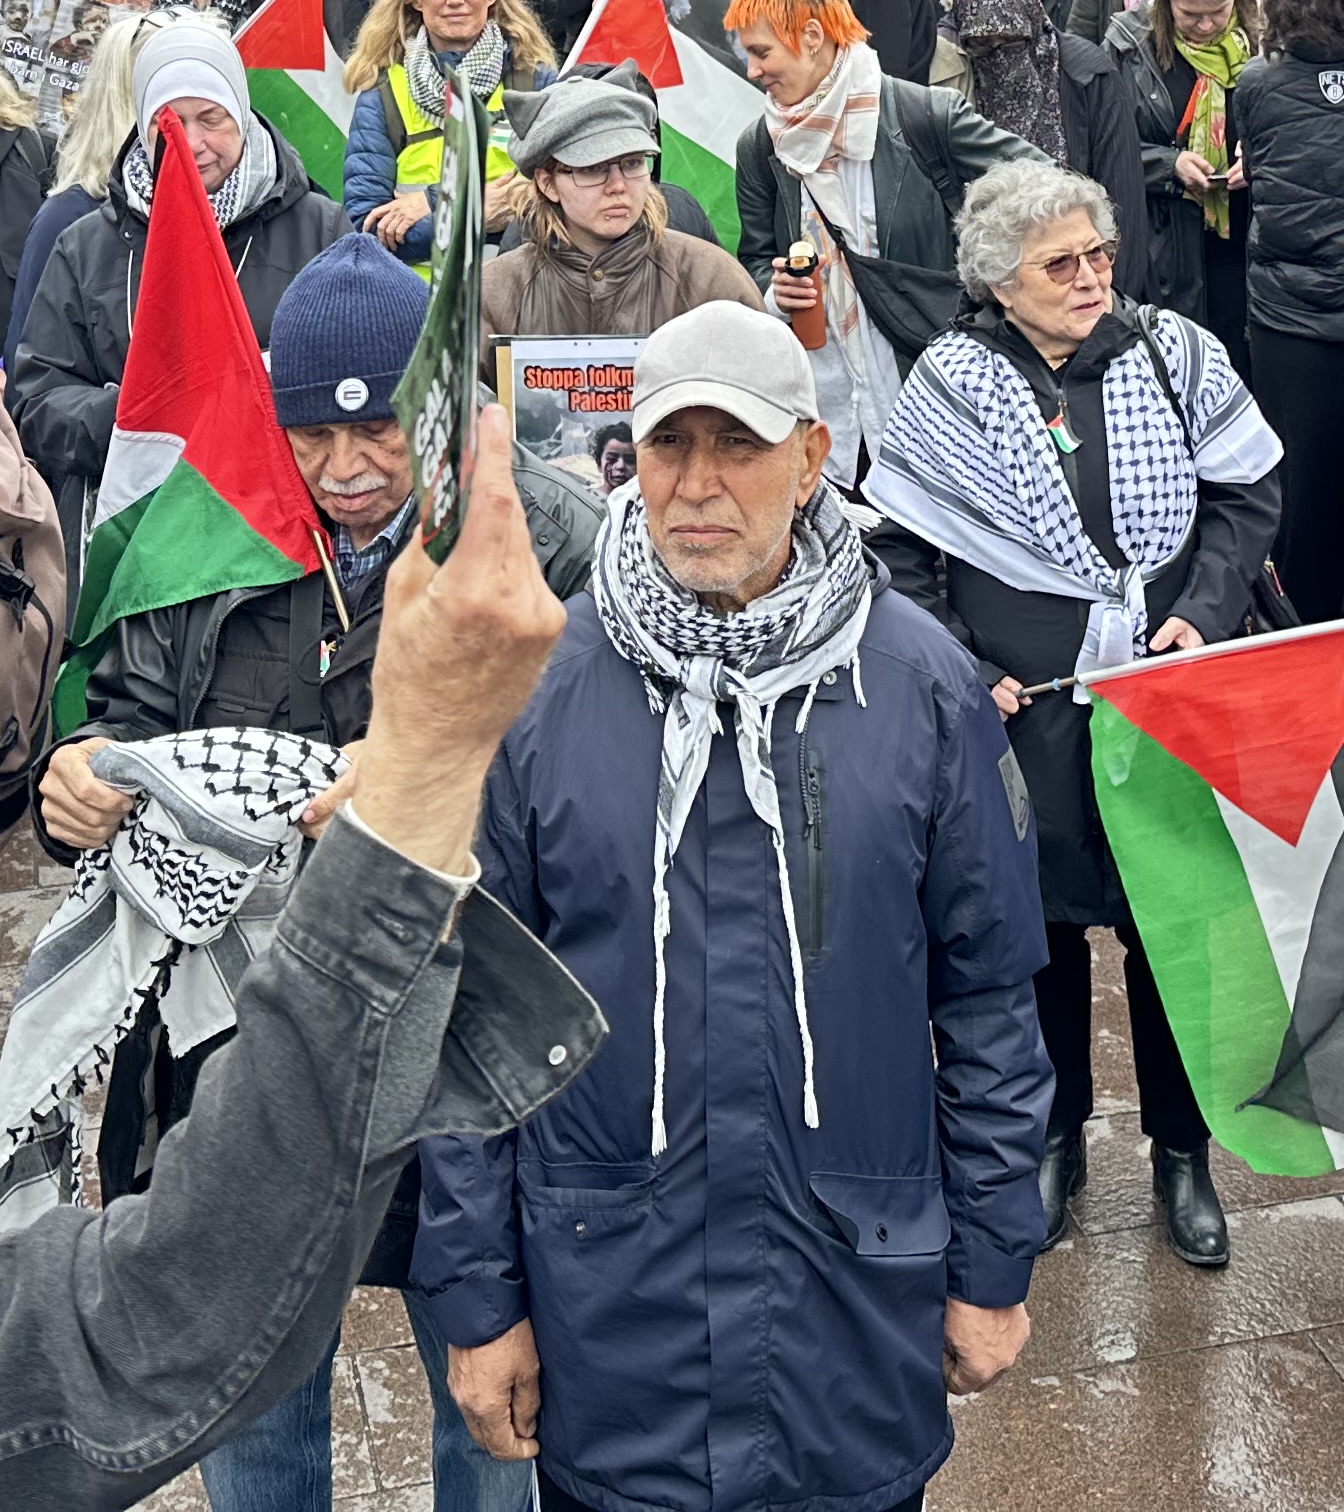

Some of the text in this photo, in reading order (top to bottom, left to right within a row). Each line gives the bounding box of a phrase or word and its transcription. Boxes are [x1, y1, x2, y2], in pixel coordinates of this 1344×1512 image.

[1, 39, 90, 76] ISRAEL har gjo
[49, 73, 80, 92] Gaza
[525, 364, 634, 390] Stoppa folkm
